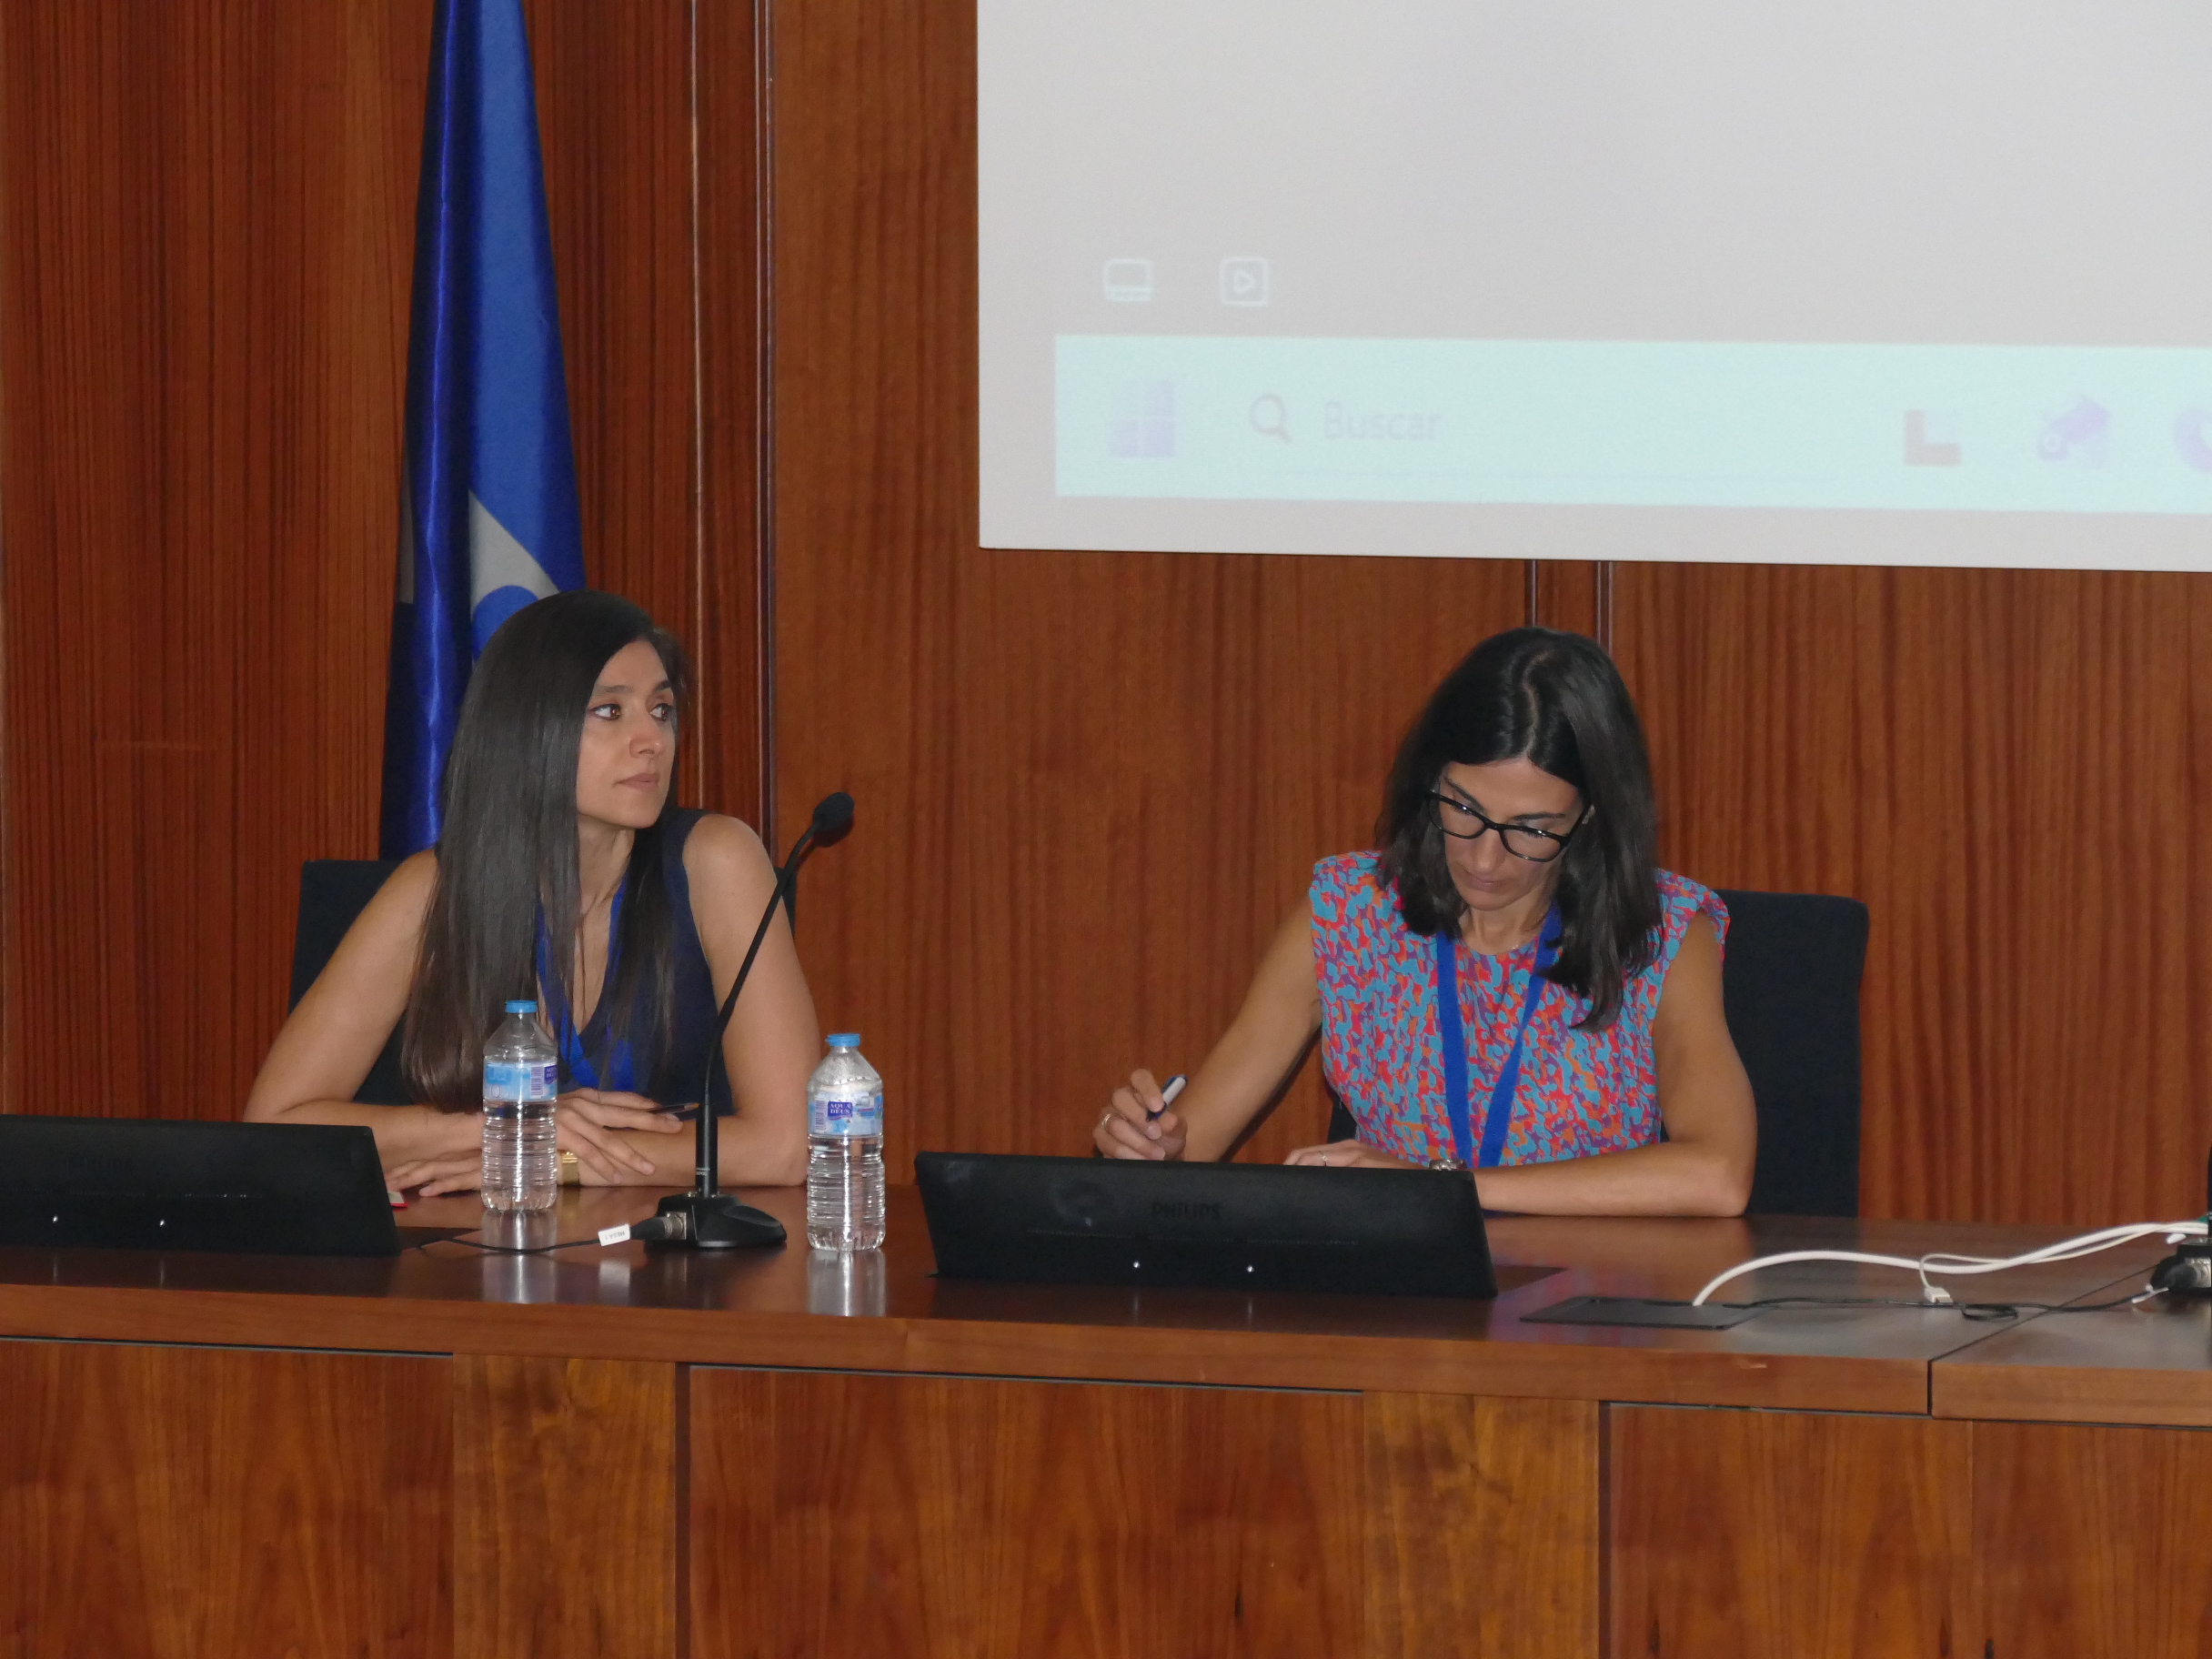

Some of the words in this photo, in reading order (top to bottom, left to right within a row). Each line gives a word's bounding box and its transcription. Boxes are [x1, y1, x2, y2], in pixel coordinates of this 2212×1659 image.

[1323, 400, 1442, 441] Buscar
[1151, 1201, 1222, 1221] PHILIPS
[608, 1231, 626, 1239] MESA
